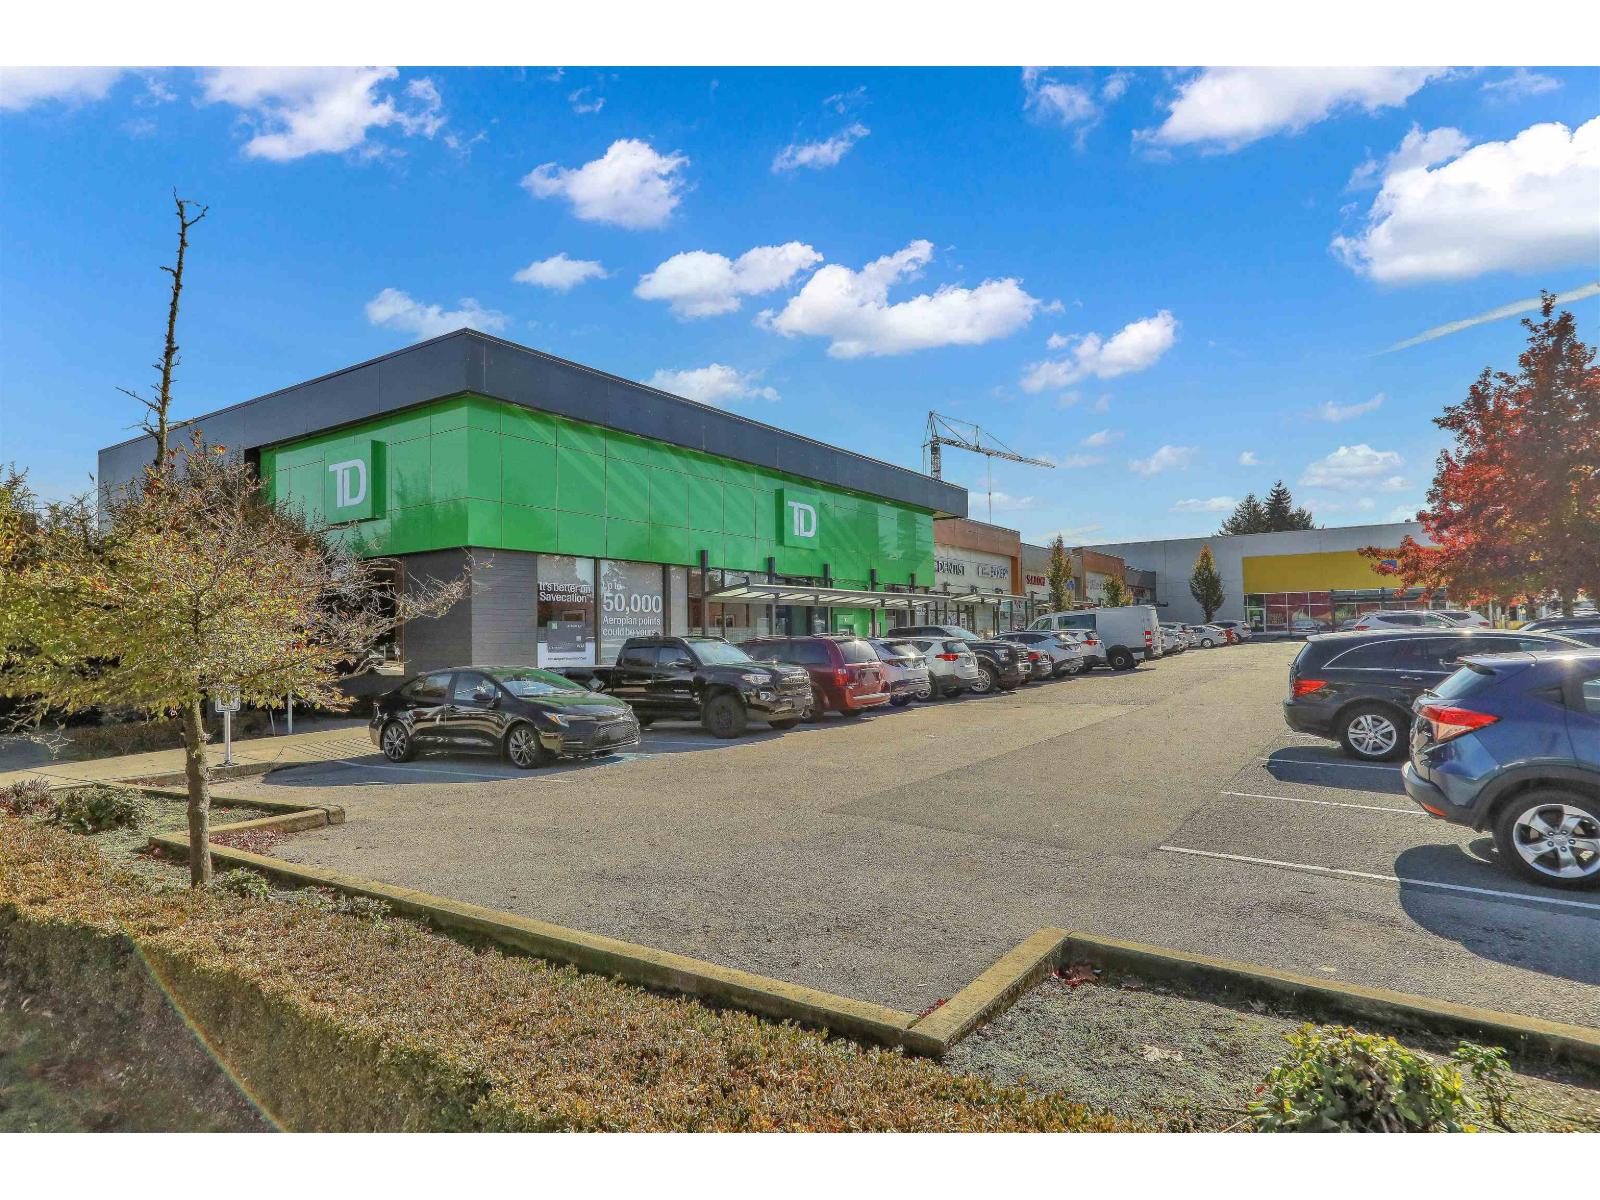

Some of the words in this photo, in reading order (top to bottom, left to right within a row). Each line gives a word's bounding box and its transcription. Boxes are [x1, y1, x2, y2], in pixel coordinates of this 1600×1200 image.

[328, 458, 367, 508] TD
[787, 500, 817, 538] TD
[540, 581, 552, 592] It's
[553, 582, 579, 593] better
[602, 592, 662, 614] 50,000
[602, 615, 637, 627] Aeroplan
[638, 616, 661, 626] points
[602, 627, 625, 636] could
